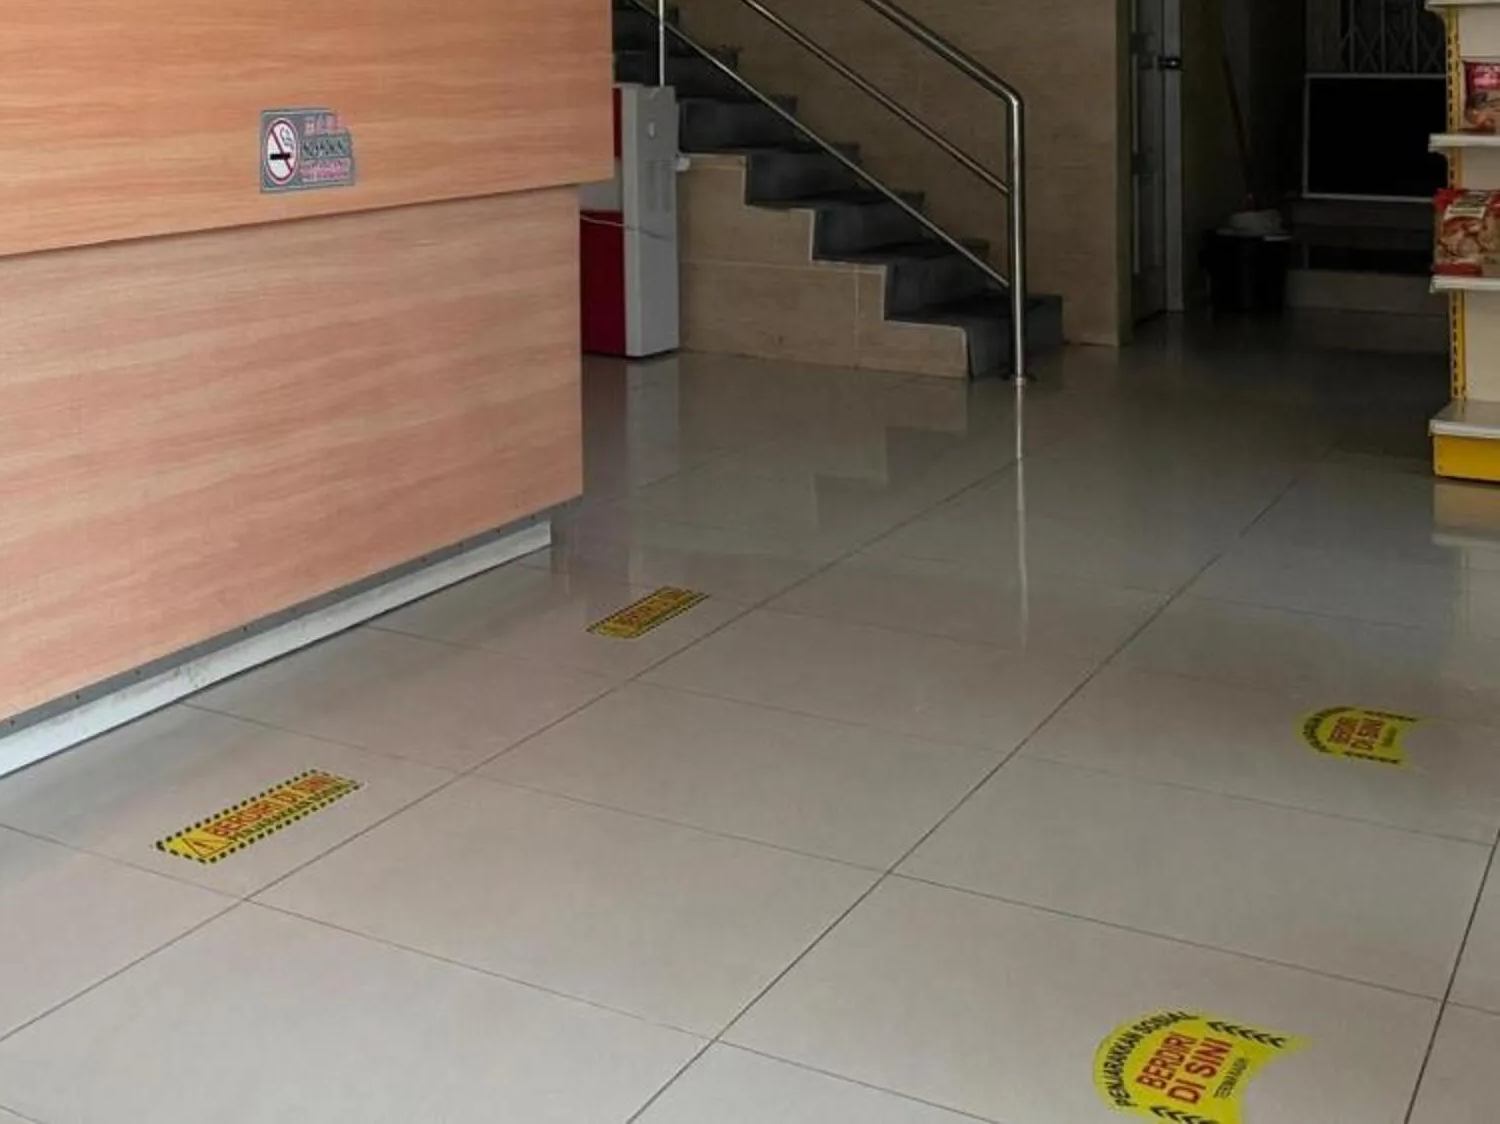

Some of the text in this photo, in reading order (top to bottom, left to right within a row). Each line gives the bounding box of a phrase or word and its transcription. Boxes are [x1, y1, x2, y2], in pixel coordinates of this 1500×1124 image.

[1136, 1032, 1199, 1090] BERDIRI
[1167, 1037, 1234, 1105] DI SINI
